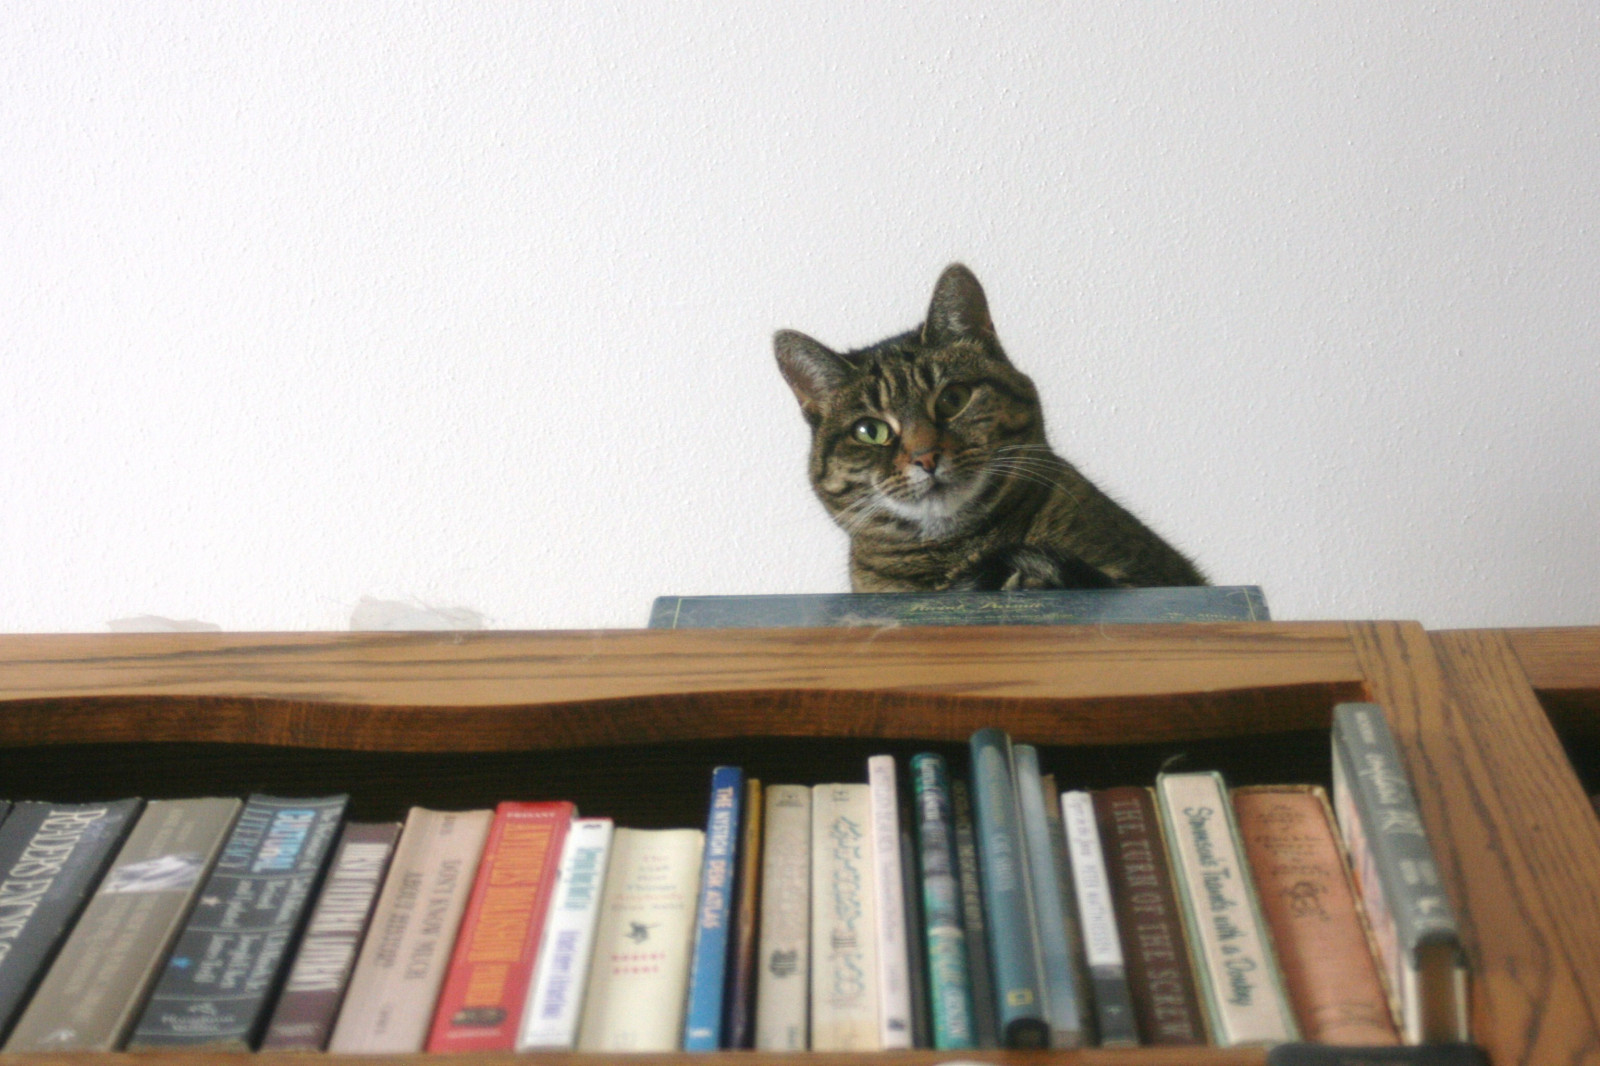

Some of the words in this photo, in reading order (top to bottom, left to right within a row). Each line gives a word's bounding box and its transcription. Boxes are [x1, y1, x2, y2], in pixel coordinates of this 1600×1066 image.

[713, 786, 734, 809] THE
[1112, 798, 1146, 834] THE
[1119, 840, 1159, 887] TURN
[1131, 892, 1165, 915] OF
[1137, 923, 1176, 963] THE
[1148, 970, 1193, 1036] SCREW
